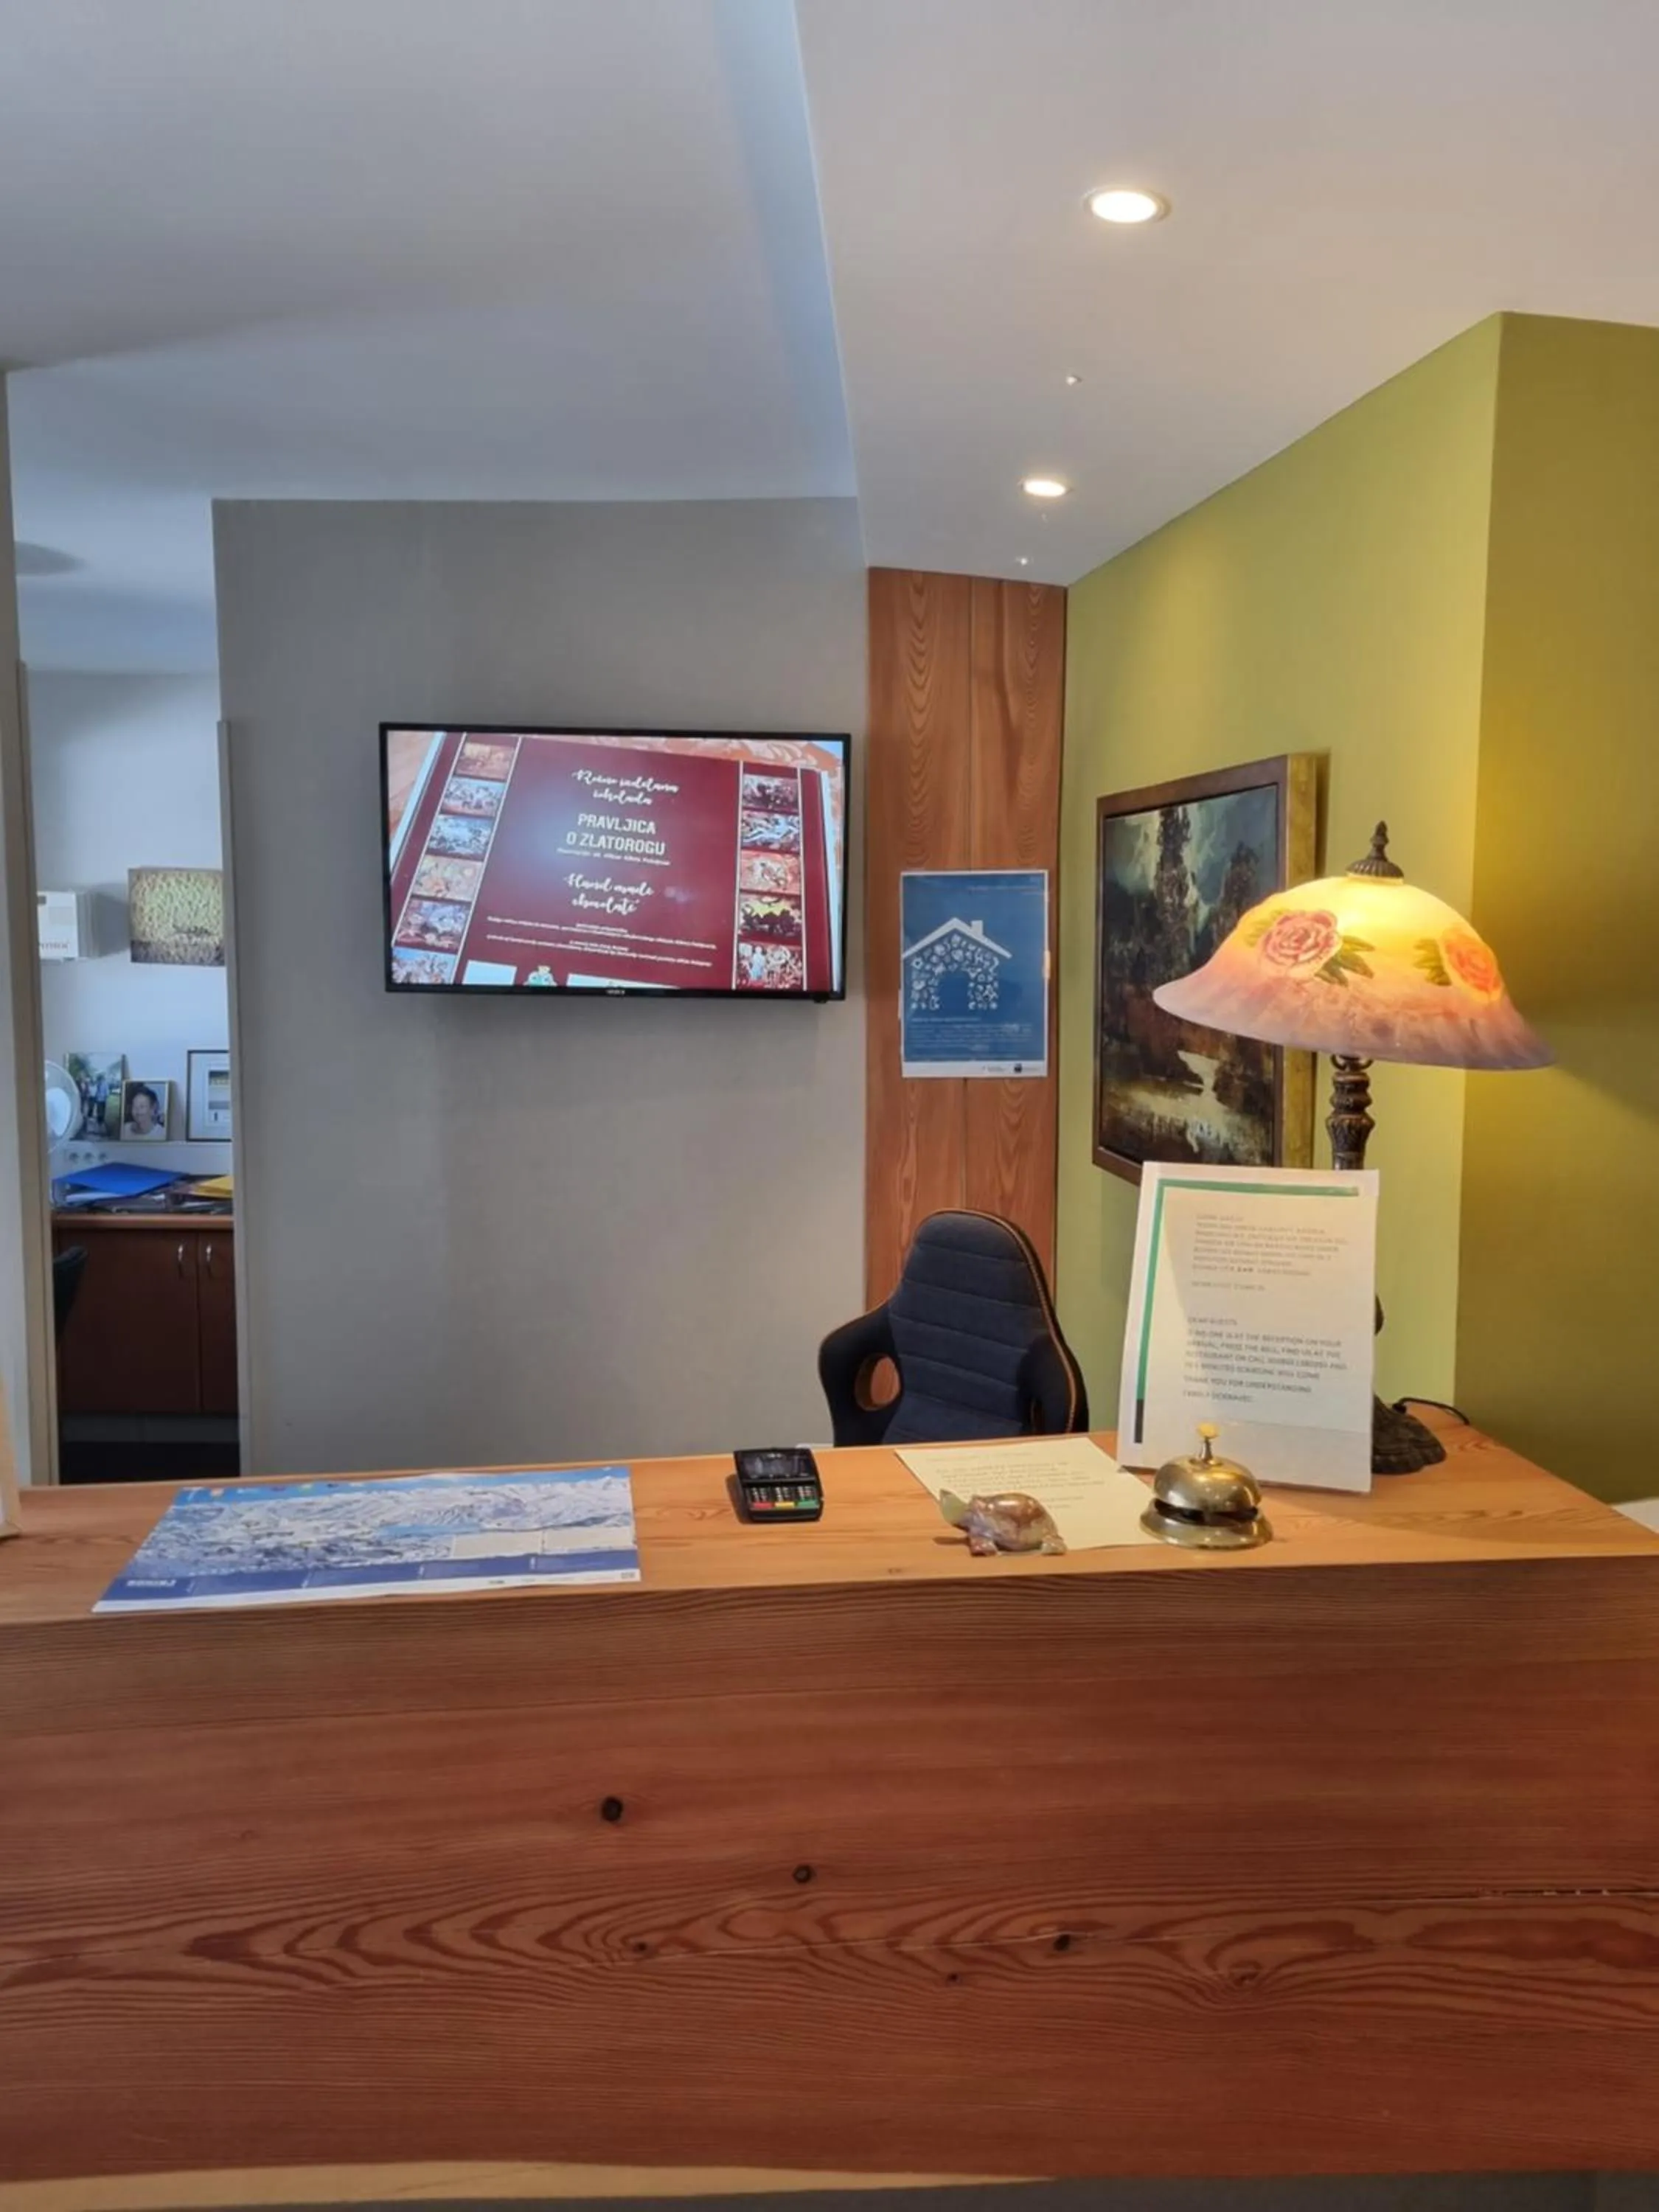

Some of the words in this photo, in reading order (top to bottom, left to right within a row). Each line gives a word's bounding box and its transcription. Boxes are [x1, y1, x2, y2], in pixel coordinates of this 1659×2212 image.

[577, 813, 656, 835] PRAVLJICA
[566, 831, 577, 845] O
[579, 832, 667, 855] ZLATOROGU
